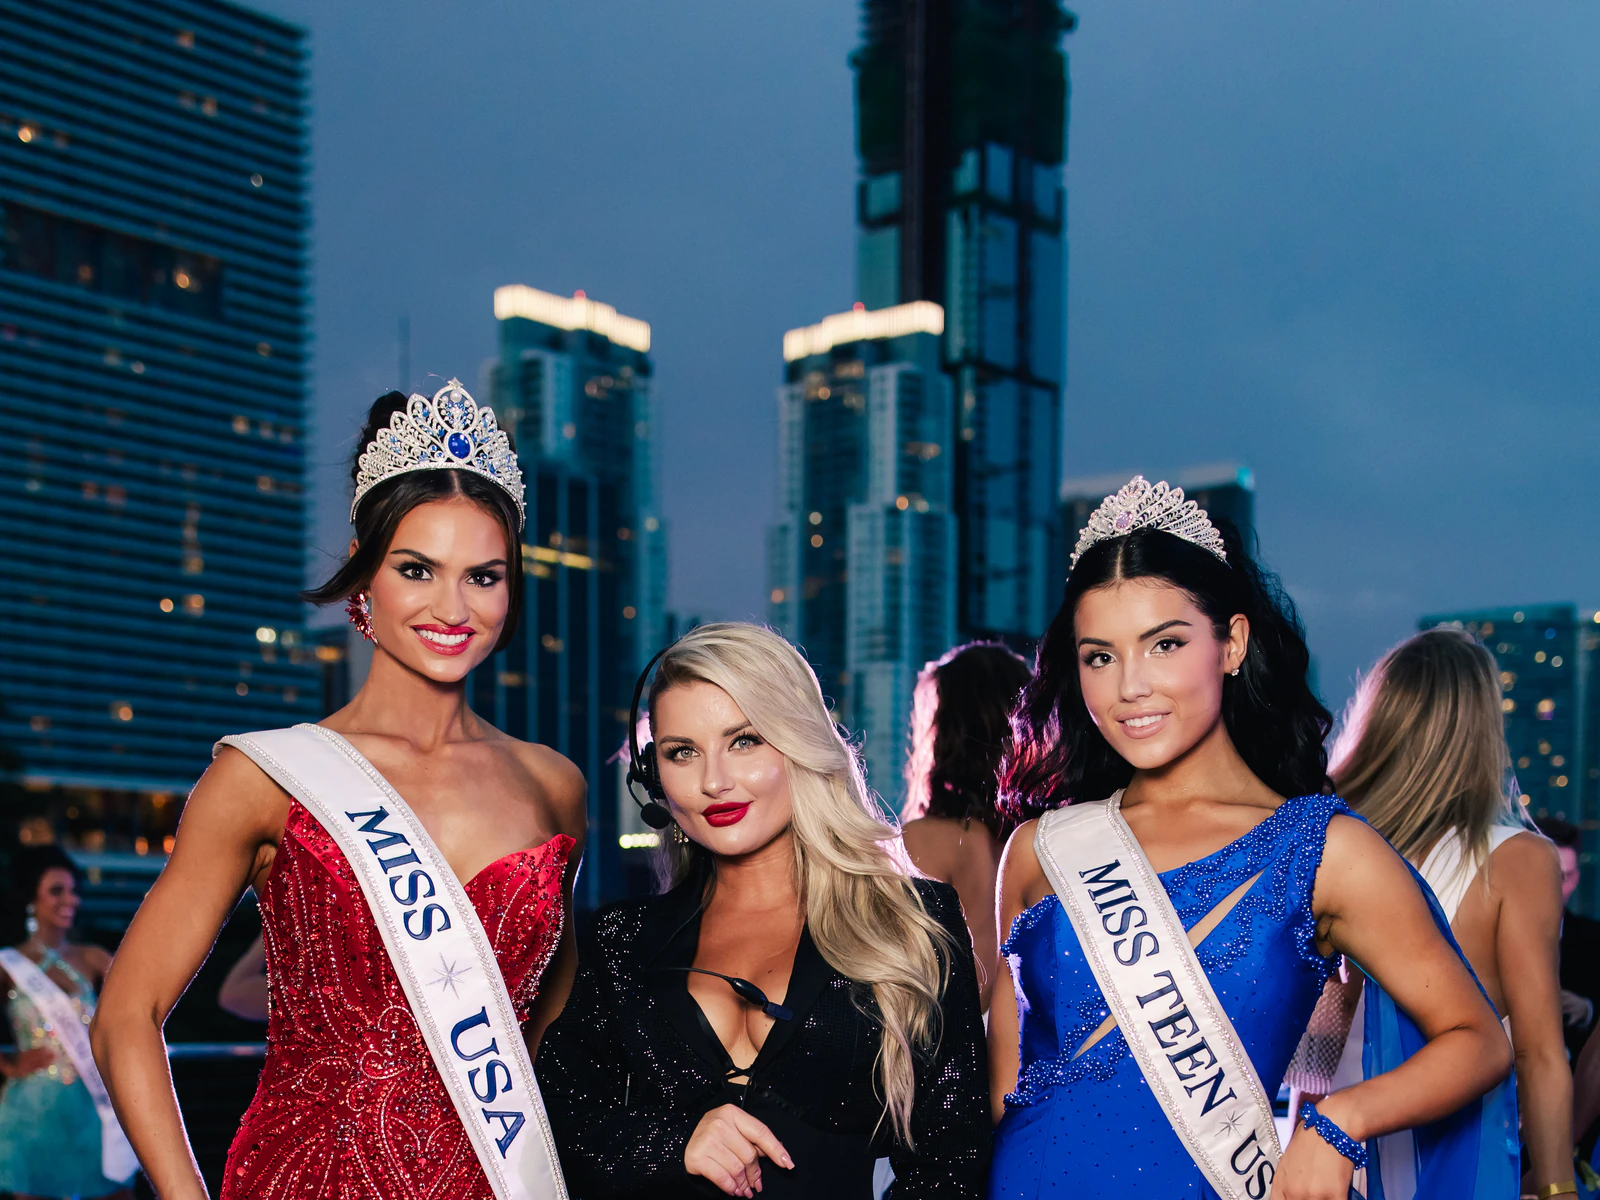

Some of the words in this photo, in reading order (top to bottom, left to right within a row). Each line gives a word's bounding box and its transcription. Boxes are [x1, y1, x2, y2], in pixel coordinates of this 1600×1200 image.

[344, 805, 452, 941] MISS
[449, 1005, 527, 1160] USA
[1078, 858, 1160, 967] MISS
[1134, 969, 1238, 1118] TEEN
